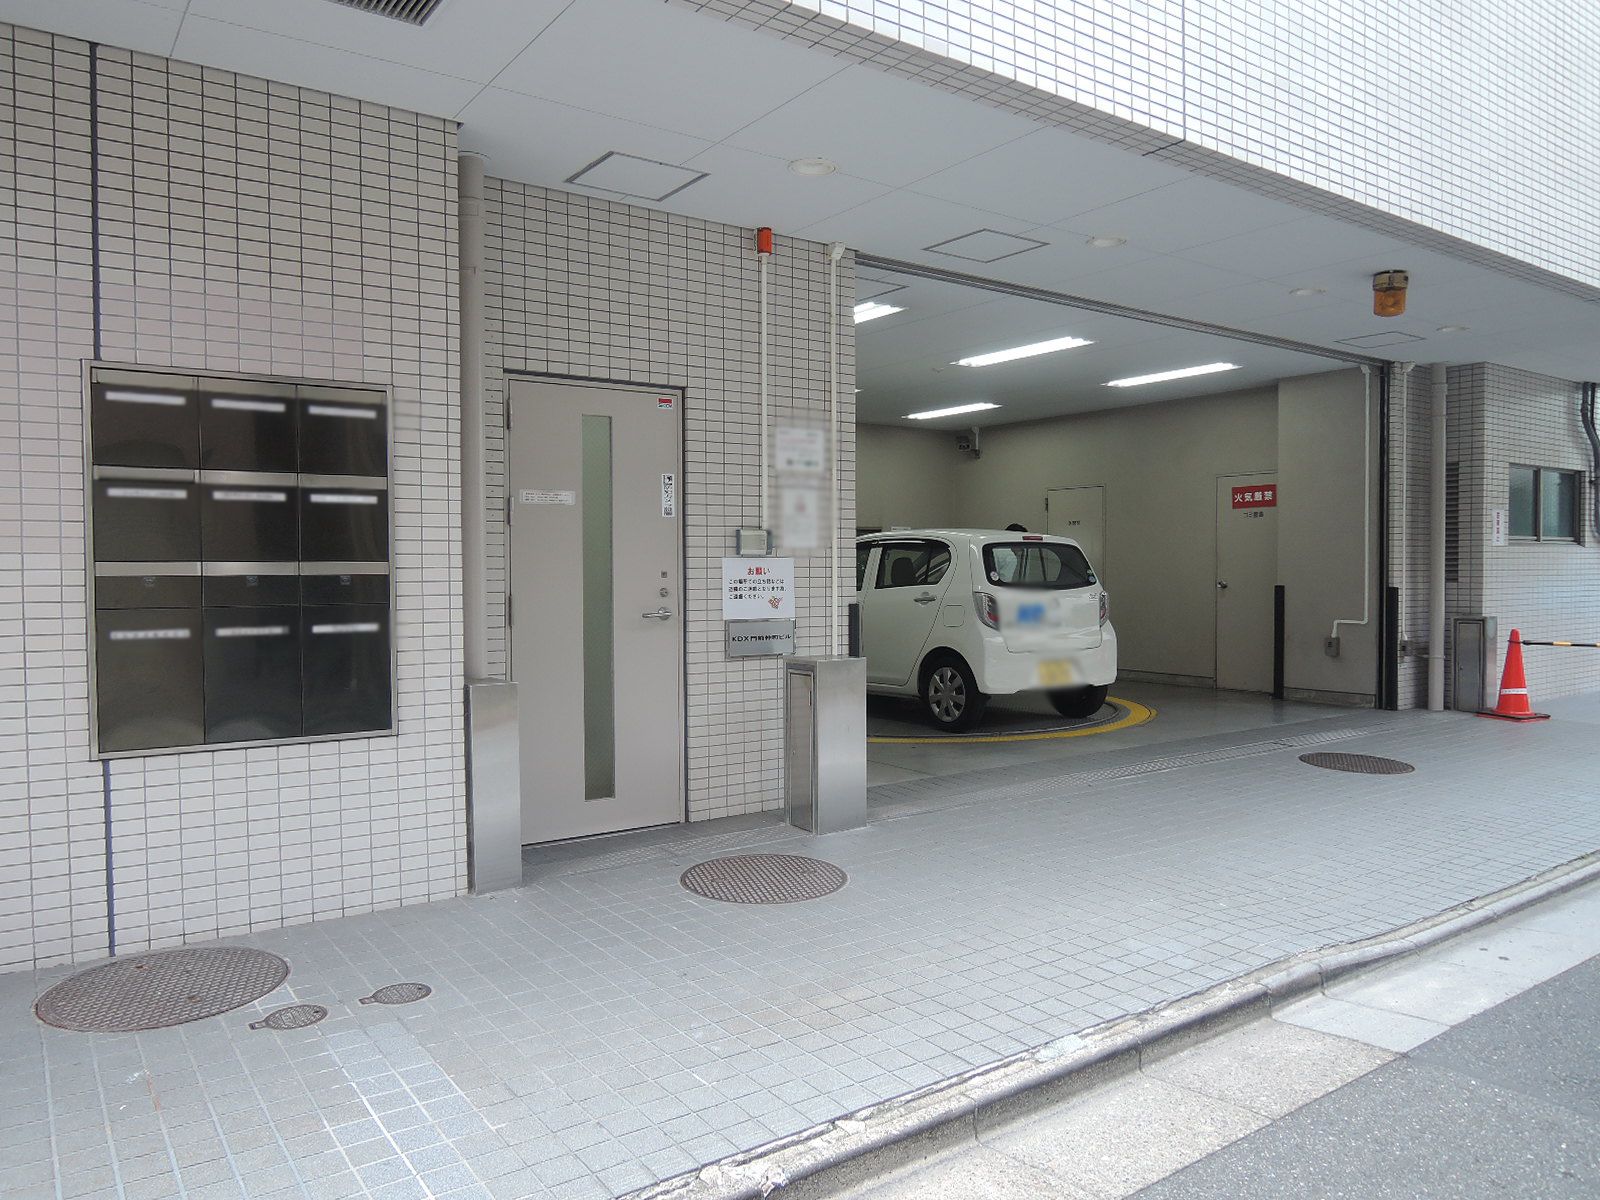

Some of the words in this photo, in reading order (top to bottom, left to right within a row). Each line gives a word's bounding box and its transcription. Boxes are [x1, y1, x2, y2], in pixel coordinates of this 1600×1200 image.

[1234, 490, 1273, 502] 火気厳禁
[747, 567, 770, 575] お願い
